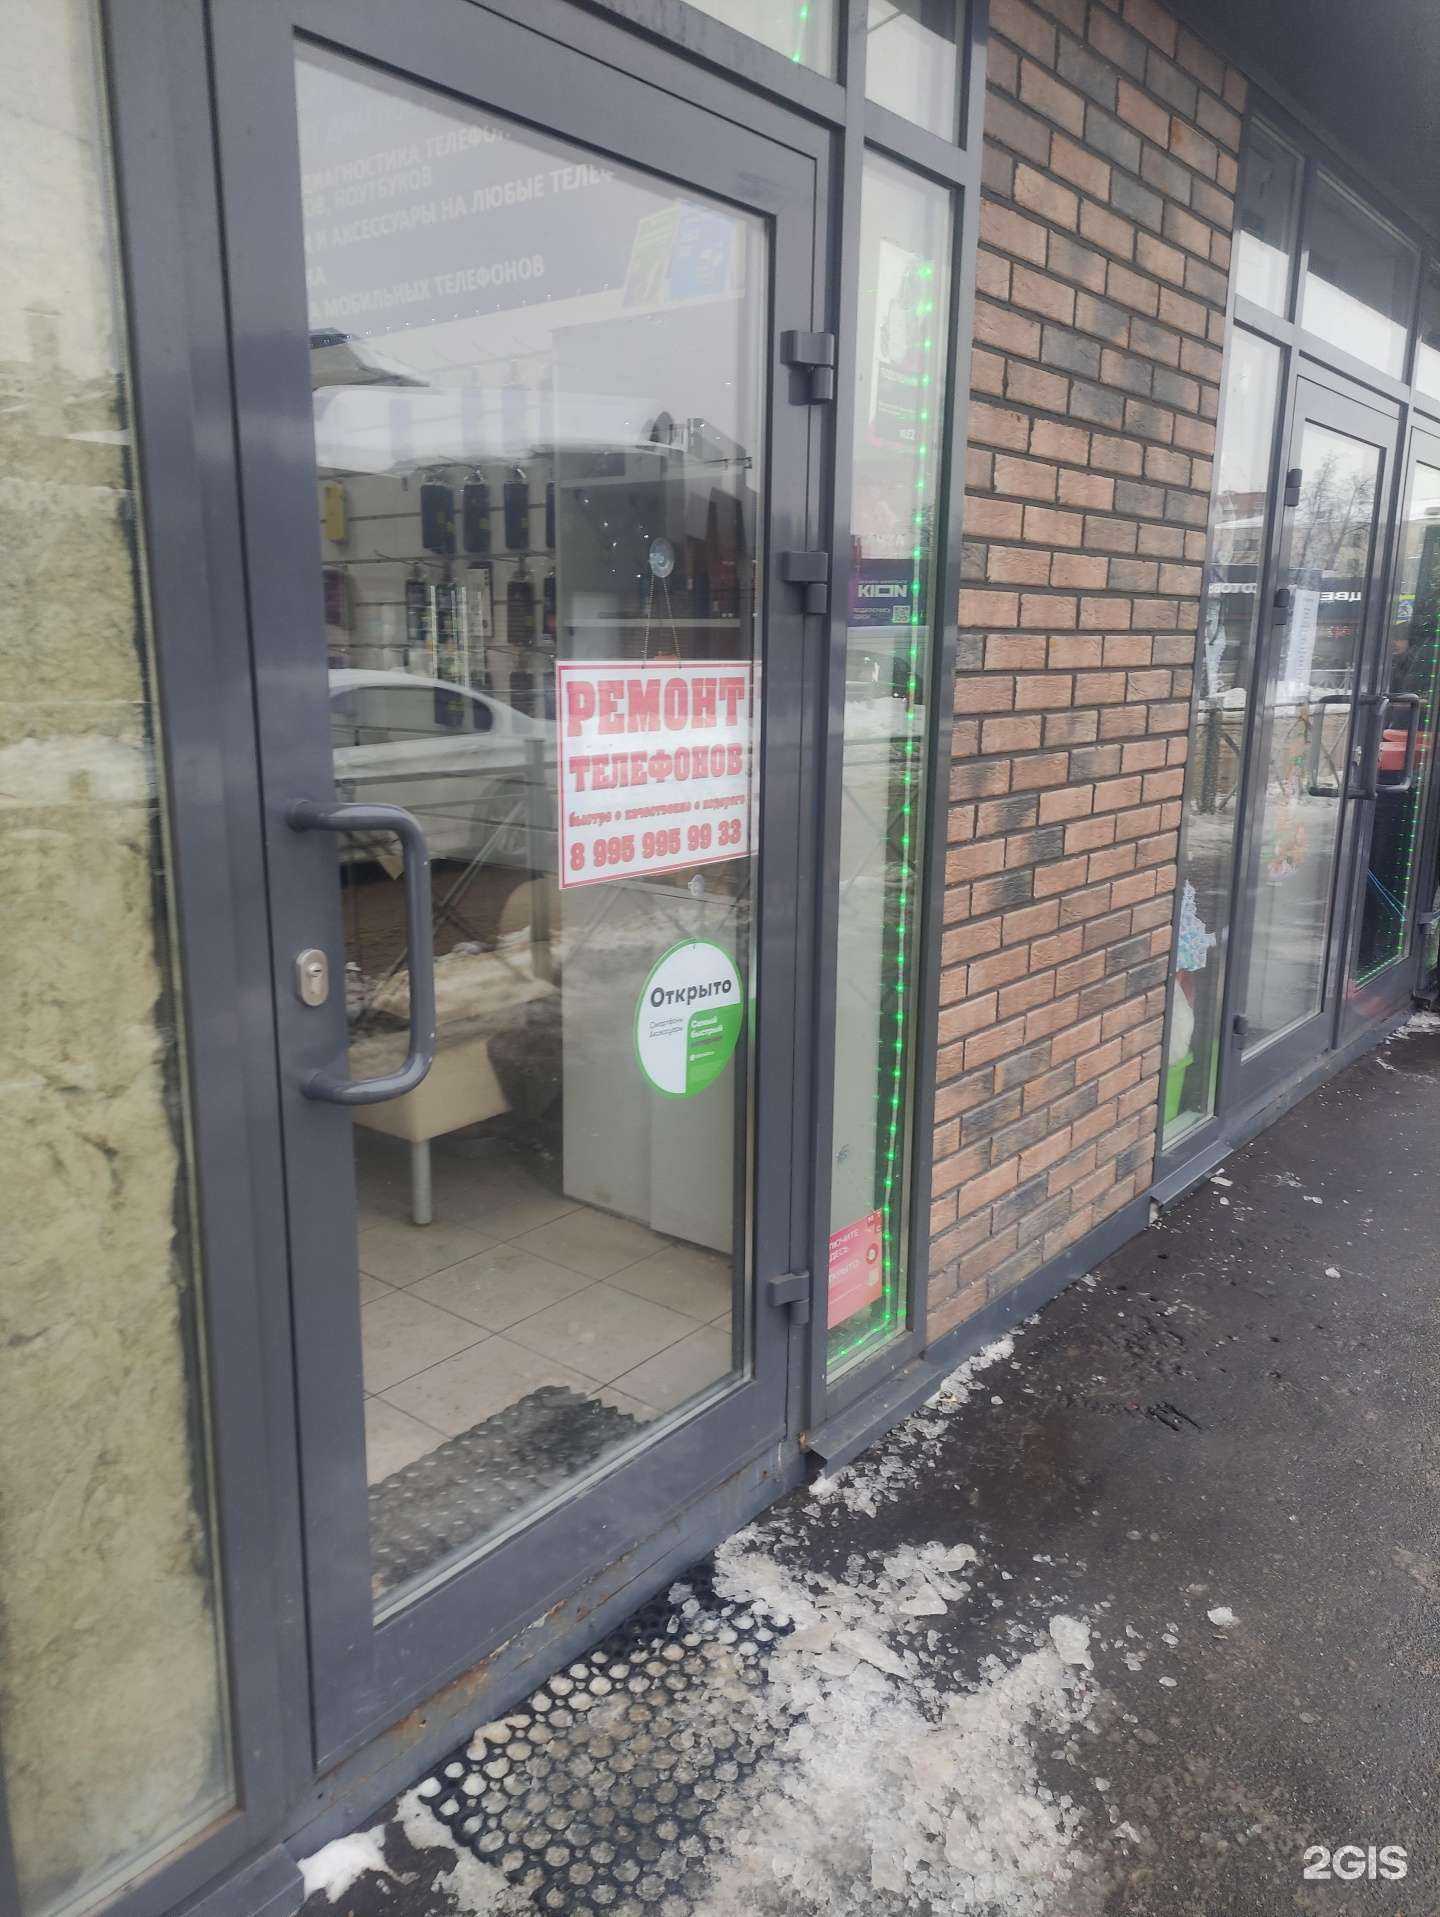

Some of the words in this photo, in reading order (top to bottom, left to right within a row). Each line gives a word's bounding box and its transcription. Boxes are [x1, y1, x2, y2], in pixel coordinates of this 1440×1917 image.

[441, 193, 467, 222] НА
[471, 174, 545, 213] ЛЮБЫЕ
[435, 254, 545, 296] ТЕЛЕФОНОВ
[857, 584, 907, 598] KION
[566, 677, 745, 737] РЕМОНТ
[569, 743, 744, 792] ТЕЛЕФОНОВ
[570, 842, 585, 871] 8
[593, 835, 635, 867] 995
[641, 828, 681, 859] 995
[687, 823, 713, 851] 99
[718, 819, 742, 846] 33
[650, 979, 732, 1008] Открыто
